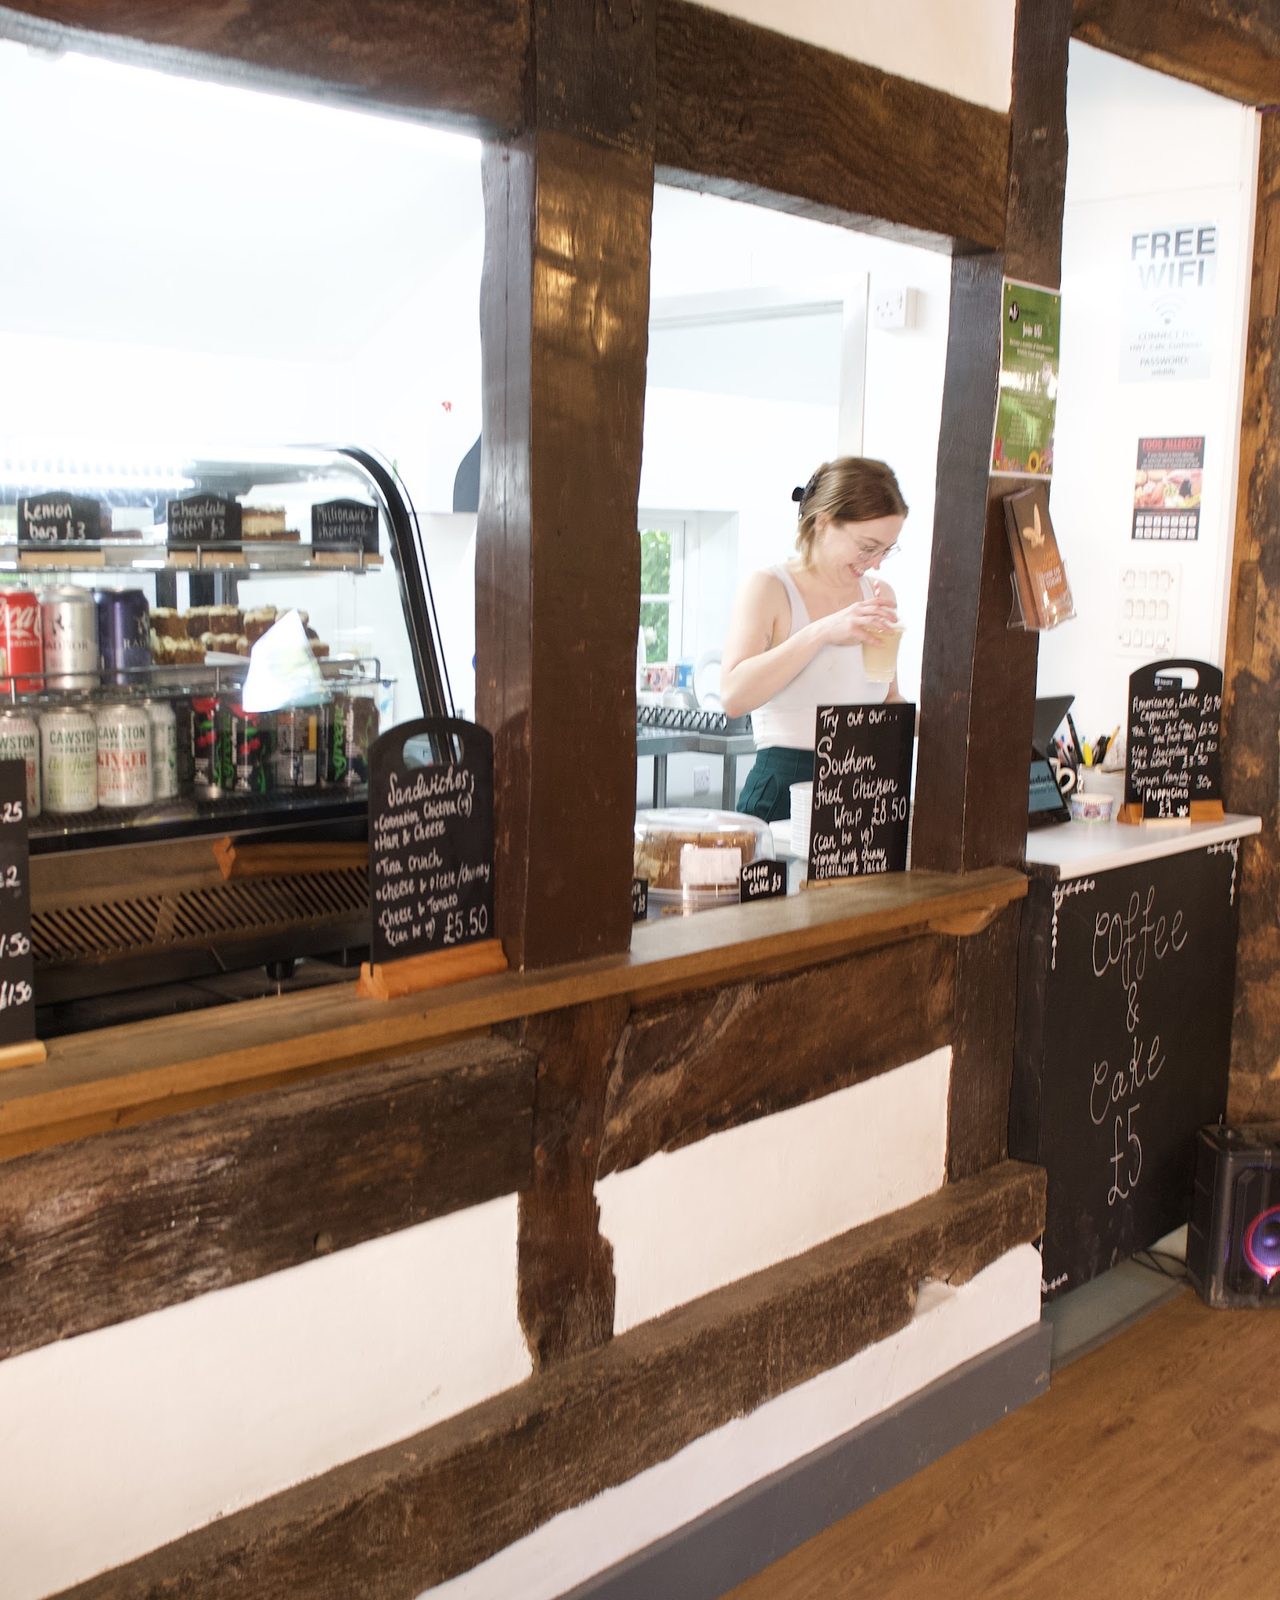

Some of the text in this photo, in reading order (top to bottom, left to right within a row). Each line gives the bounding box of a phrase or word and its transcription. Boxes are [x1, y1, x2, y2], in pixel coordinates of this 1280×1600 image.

[1131, 227, 1217, 260] FREE
[1139, 259, 1205, 289] WIFI
[24, 499, 73, 522] Lemon
[97, 726, 146, 741] CAWSTON
[820, 706, 840, 738] Try
[847, 706, 864, 728] out
[817, 735, 877, 780] Southern
[852, 775, 898, 802] Chicken
[834, 796, 908, 830] Wrap £8.50
[379, 819, 446, 852] Ham & Cheese
[813, 832, 837, 856] (can
[841, 828, 853, 847] be
[419, 877, 427, 895] &
[742, 864, 769, 883] Coffee
[443, 903, 488, 945] £5.50
[1092, 885, 1188, 990] Coffee
[1127, 981, 1140, 1033] &
[1107, 1103, 1143, 1206] £5
